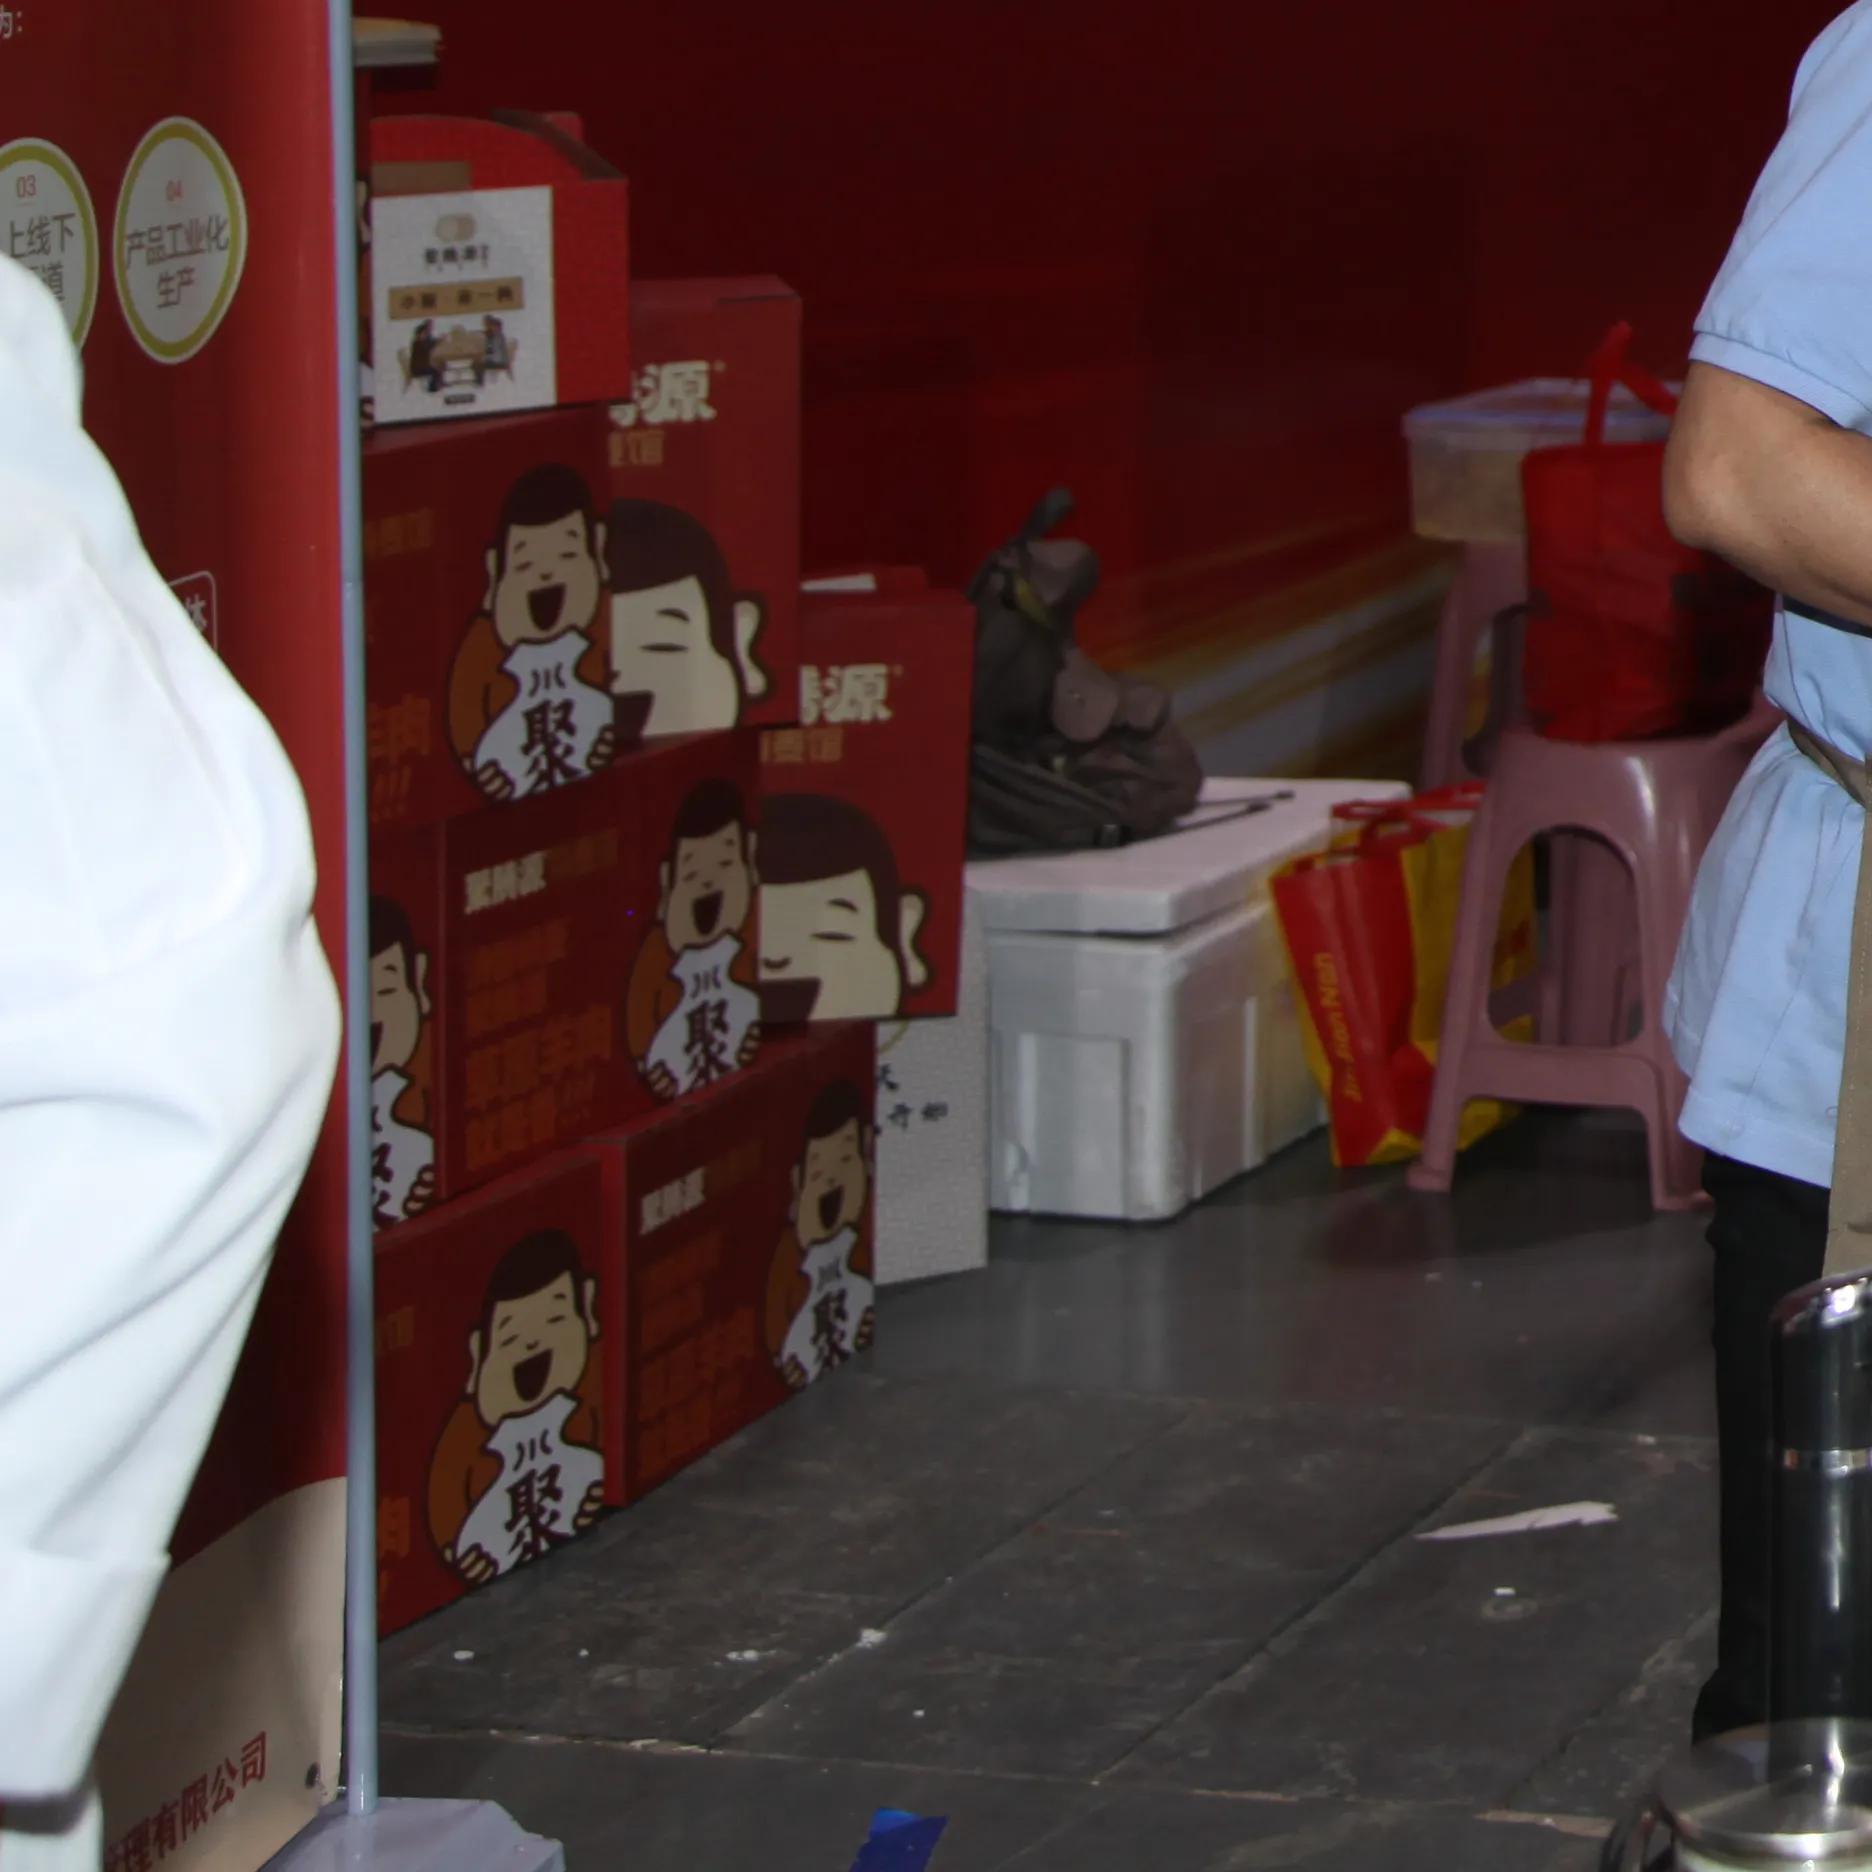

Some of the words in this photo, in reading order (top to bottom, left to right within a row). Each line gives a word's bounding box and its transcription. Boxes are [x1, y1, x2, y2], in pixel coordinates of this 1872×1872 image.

[16, 175, 37, 198] 03
[126, 214, 229, 271] 产品工业化
[157, 266, 195, 309] 生产
